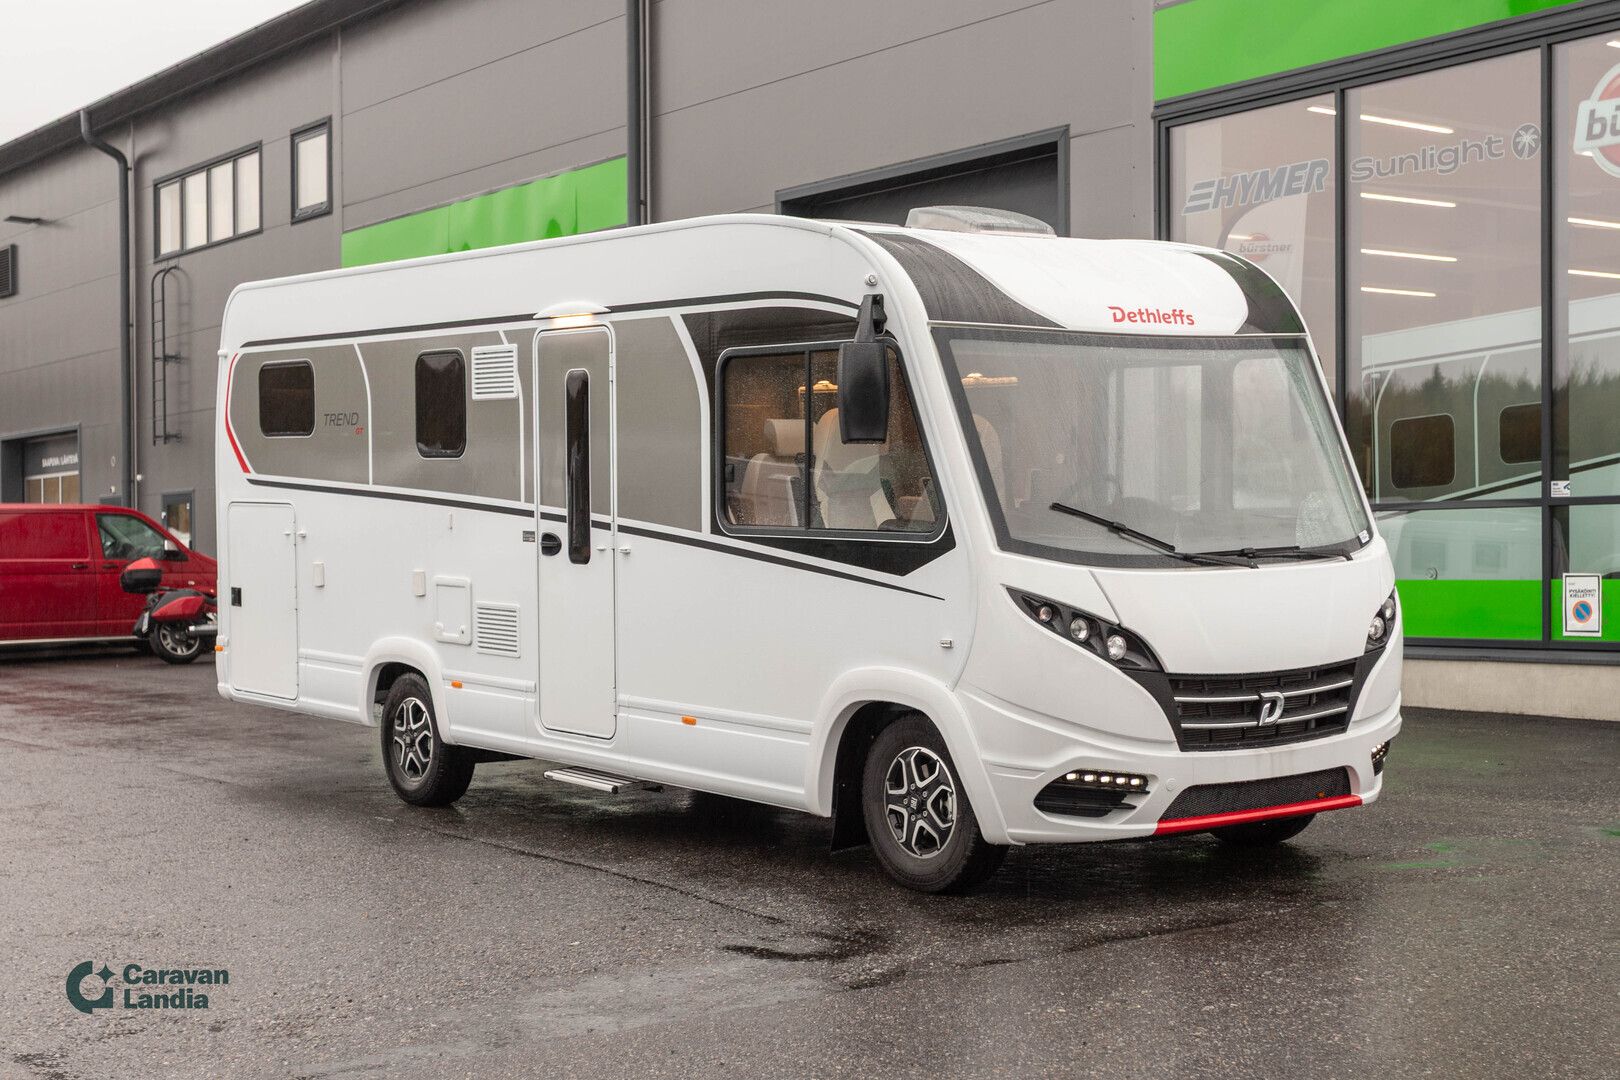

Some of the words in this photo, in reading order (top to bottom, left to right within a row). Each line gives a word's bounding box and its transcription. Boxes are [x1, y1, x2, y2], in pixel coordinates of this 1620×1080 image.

[1350, 135, 1505, 182] Sunlight
[1211, 159, 1330, 209] HYMER
[1239, 243, 1292, 253] bürstner
[1107, 306, 1195, 326] Dethleffs
[323, 412, 359, 427] TREND
